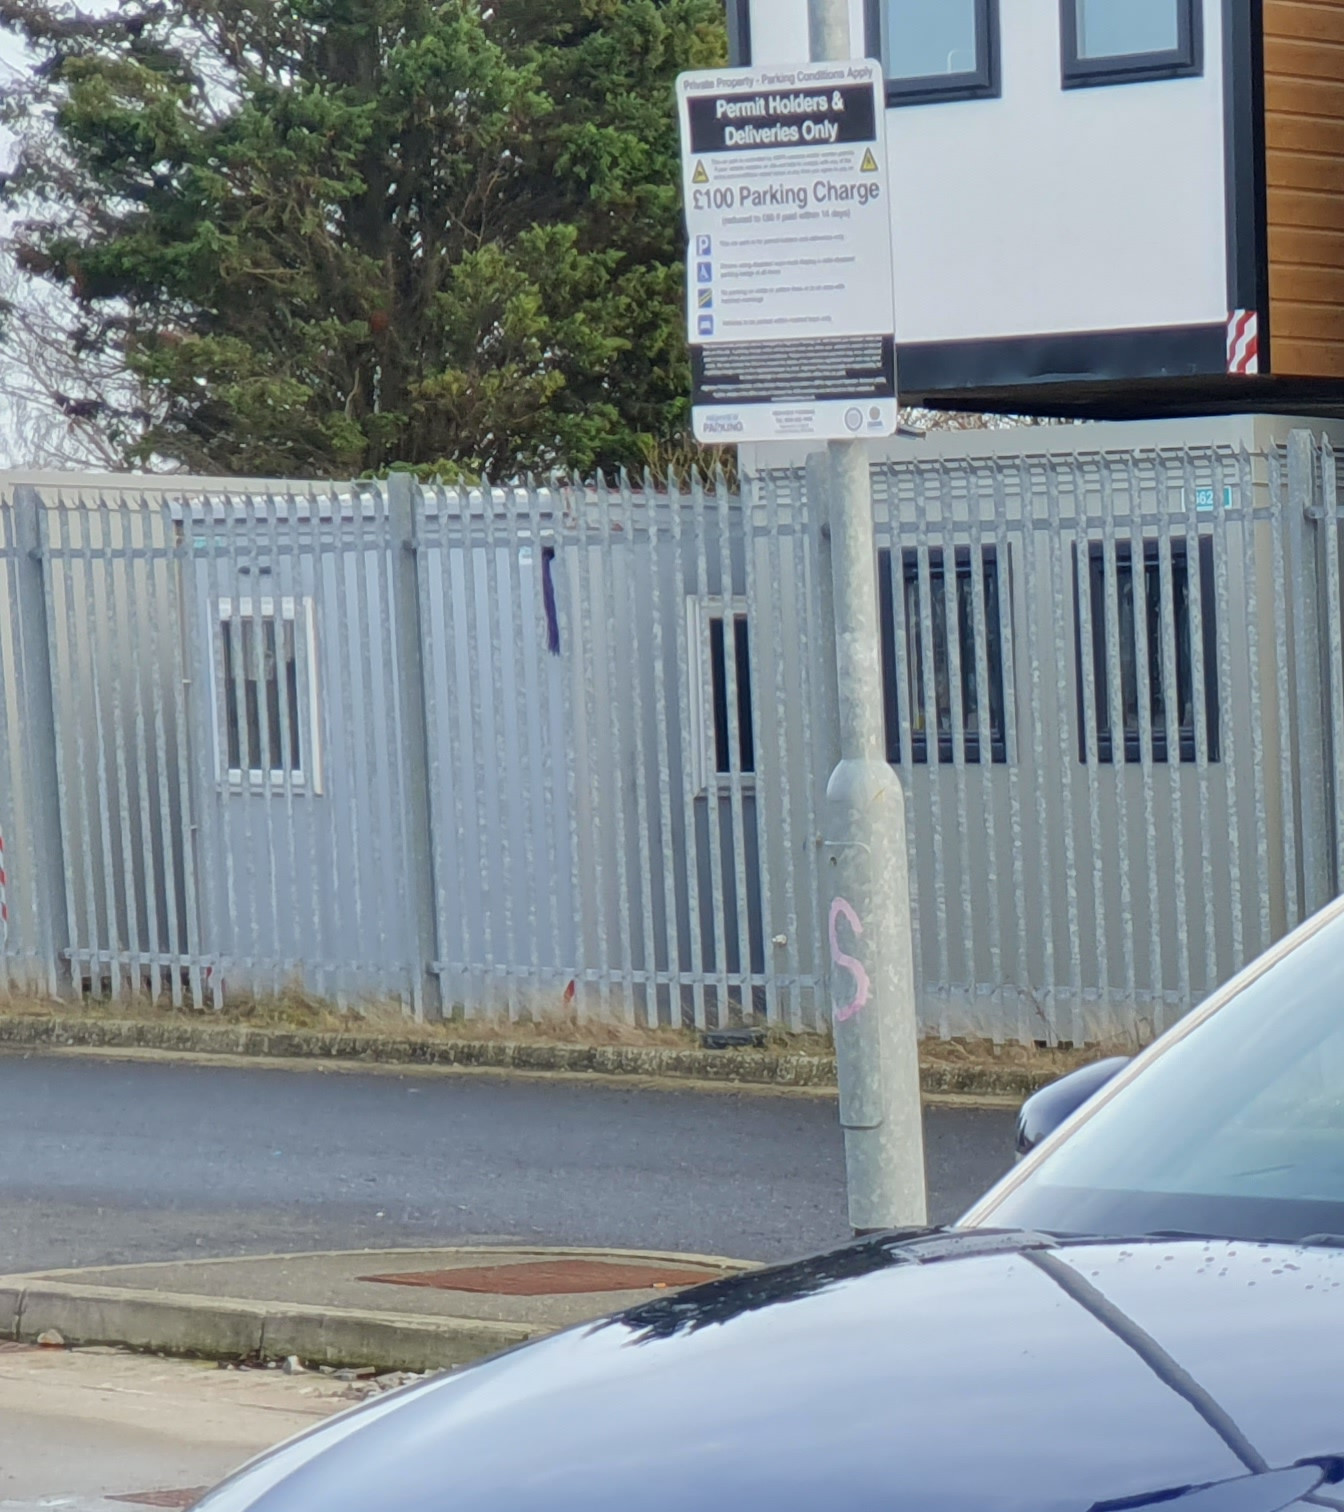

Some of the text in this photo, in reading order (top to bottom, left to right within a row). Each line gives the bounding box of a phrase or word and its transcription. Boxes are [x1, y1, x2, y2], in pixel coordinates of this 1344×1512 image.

[683, 80, 714, 91] Private
[716, 75, 754, 89] Property
[762, 73, 795, 86] Parking
[797, 67, 844, 82] Conditions
[847, 66, 873, 79] Apply
[716, 90, 845, 119] Permit Holders &
[725, 119, 838, 146] Deliveries Only
[693, 180, 880, 210] £100 Parking Charge
